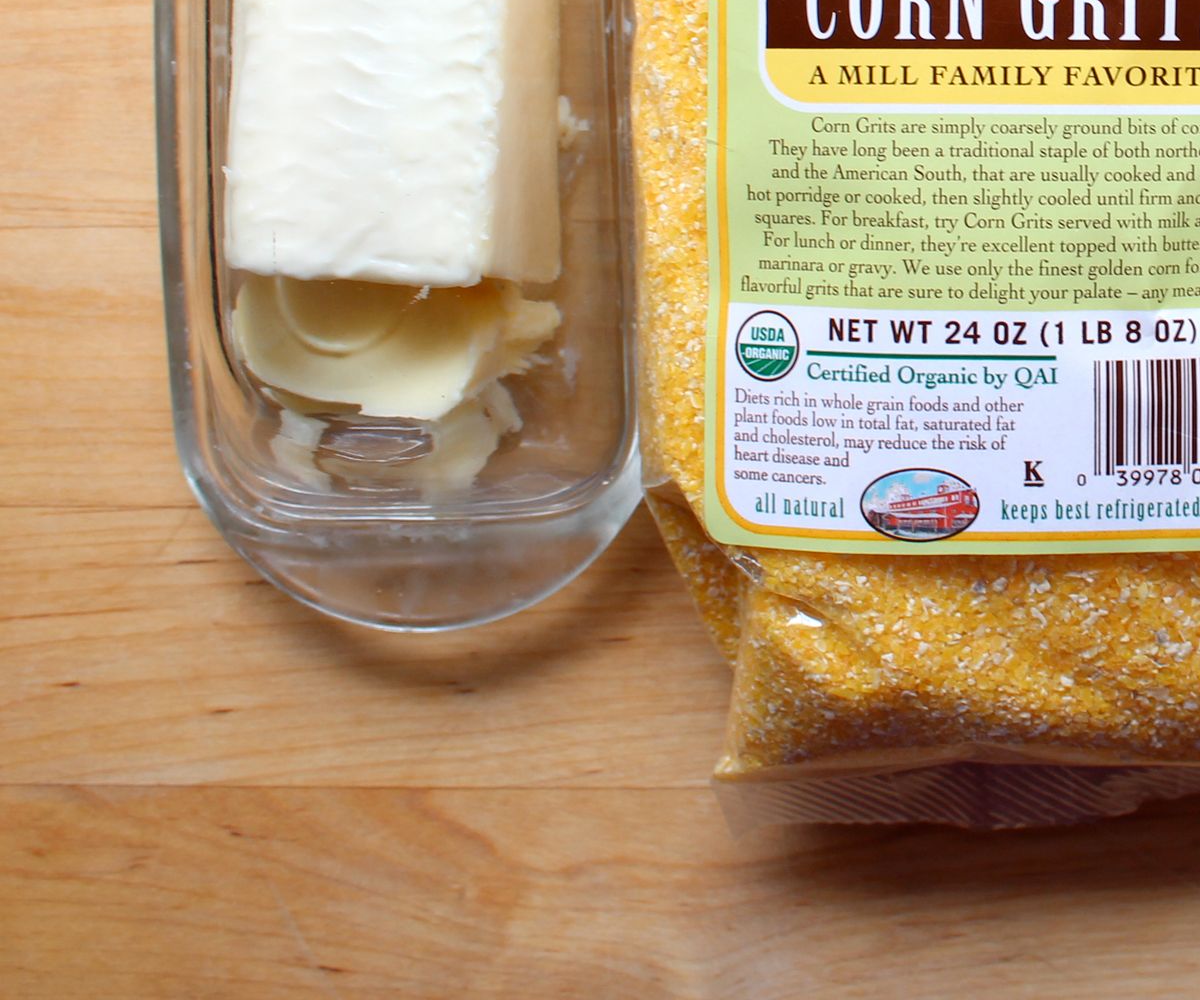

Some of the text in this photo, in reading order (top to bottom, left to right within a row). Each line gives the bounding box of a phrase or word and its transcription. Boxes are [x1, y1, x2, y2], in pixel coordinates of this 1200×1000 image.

[808, 65, 827, 87] A
[837, 65, 919, 85] MILL
[931, 65, 1054, 87] FAMILY
[811, 116, 850, 133] Corn
[855, 116, 896, 134] Grits
[901, 123, 926, 134] are
[931, 116, 986, 139] simply
[990, 117, 1058, 140] coarsely
[1062, 117, 1122, 140] ground
[1127, 117, 1157, 135] bits
[768, 138, 808, 161] They
[812, 139, 848, 156] have
[853, 139, 887, 162] long
[892, 140, 930, 157] been
[949, 140, 1034, 158] traditional
[1039, 141, 1087, 163] staple
[1114, 141, 1150, 158] both
[771, 162, 800, 179] and
[804, 162, 828, 180] the
[832, 164, 908, 181] American
[914, 163, 967, 183] South,
[972, 164, 1005, 181] that
[1009, 171, 1036, 182] are
[1040, 164, 1099, 187] usually
[1104, 164, 1162, 182] cooked
[1166, 164, 1196, 182] and
[746, 184, 771, 201] hot
[775, 185, 840, 208] porridge
[865, 187, 926, 206] cooked,
[932, 187, 968, 205] then
[973, 188, 1033, 211] slightly
[1038, 188, 1091, 206] cooled
[1097, 188, 1134, 206] until
[1139, 188, 1172, 205] firm
[754, 214, 816, 229] squares.
[821, 210, 848, 226] For
[852, 209, 929, 230] breakfast,
[934, 216, 959, 234] try
[964, 212, 1005, 229] Corn
[1011, 212, 1053, 229] Grits
[1058, 212, 1112, 229] served
[1116, 212, 1152, 229] with
[1158, 211, 1190, 229] milk
[763, 231, 790, 247] For
[794, 231, 835, 249] lunch
[860, 233, 915, 253] dinner,
[920, 234, 977, 257] they're
[982, 235, 1055, 253] excellent
[1060, 235, 1117, 258] topped
[1121, 235, 1157, 253] with
[759, 254, 824, 272] marinara
[848, 263, 896, 280] gravy.
[902, 259, 930, 275] We
[935, 265, 962, 276] use
[967, 259, 1003, 281] only
[1008, 259, 1034, 276] the
[1039, 259, 1084, 276] finest
[1088, 259, 1143, 281] golden
[1148, 264, 1180, 276] corn
[741, 275, 802, 294] flavorful
[805, 279, 839, 300] grits
[843, 279, 873, 297] that
[878, 288, 903, 298] are
[908, 288, 943, 299] sure
[968, 282, 1025, 305] delight
[1030, 287, 1069, 304] your
[1073, 282, 1122, 304] palate
[1141, 288, 1169, 304] any
[751, 327, 785, 342] USDA
[829, 318, 878, 343] NET
[890, 320, 933, 344] WT
[944, 320, 981, 345] 24
[994, 321, 1027, 345] OZ
[1040, 321, 1064, 348] (1
[1081, 320, 1112, 345] LB
[1125, 320, 1142, 344] 8
[1155, 318, 1197, 344] OZ)
[744, 346, 790, 361] ORGANIC
[807, 362, 1058, 390] Certified Organic by QAI
[735, 387, 1024, 415] Diets rich whole grain foods and other
[734, 407, 1015, 432] plant foods low total fat, saturated fat
[734, 427, 1008, 454] and cholesterol, may reduce the risk of
[734, 444, 850, 468] heart disease and
[734, 470, 827, 485] some cancers.
[1024, 460, 1045, 482] K
[1116, 469, 1182, 487] 39978
[754, 493, 844, 518] all natural
[1001, 499, 1047, 524] keeps
[1055, 499, 1090, 520] best
[1097, 496, 1200, 522] refrigerated
